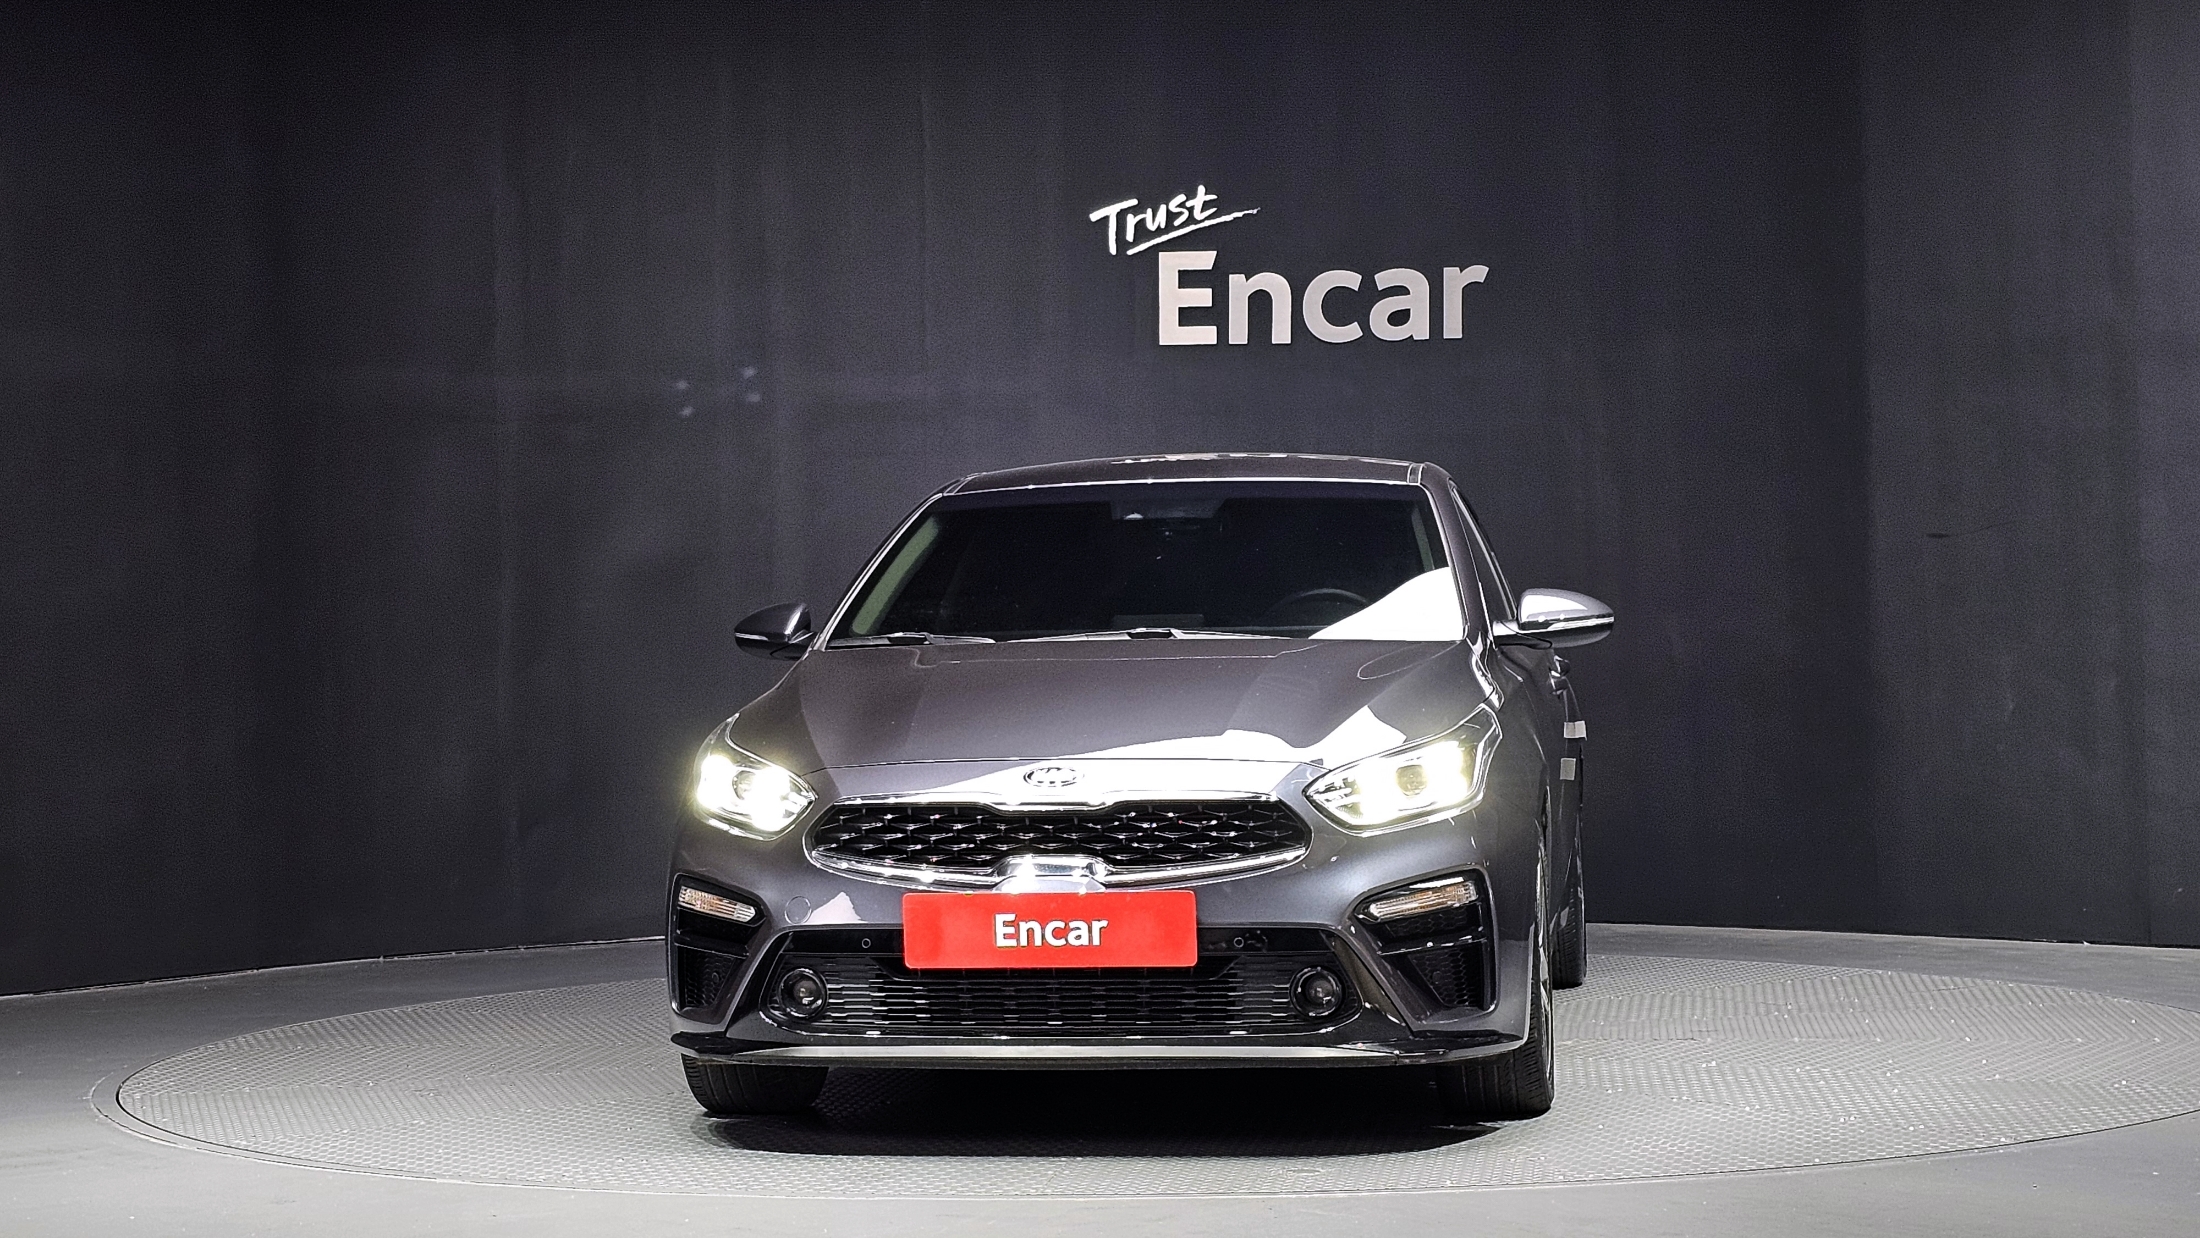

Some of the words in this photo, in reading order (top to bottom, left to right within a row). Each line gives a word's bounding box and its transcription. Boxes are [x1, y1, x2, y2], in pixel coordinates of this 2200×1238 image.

[1089, 184, 1219, 256] Trust
[1158, 250, 1490, 346] Encar
[993, 913, 1108, 947] Encar
